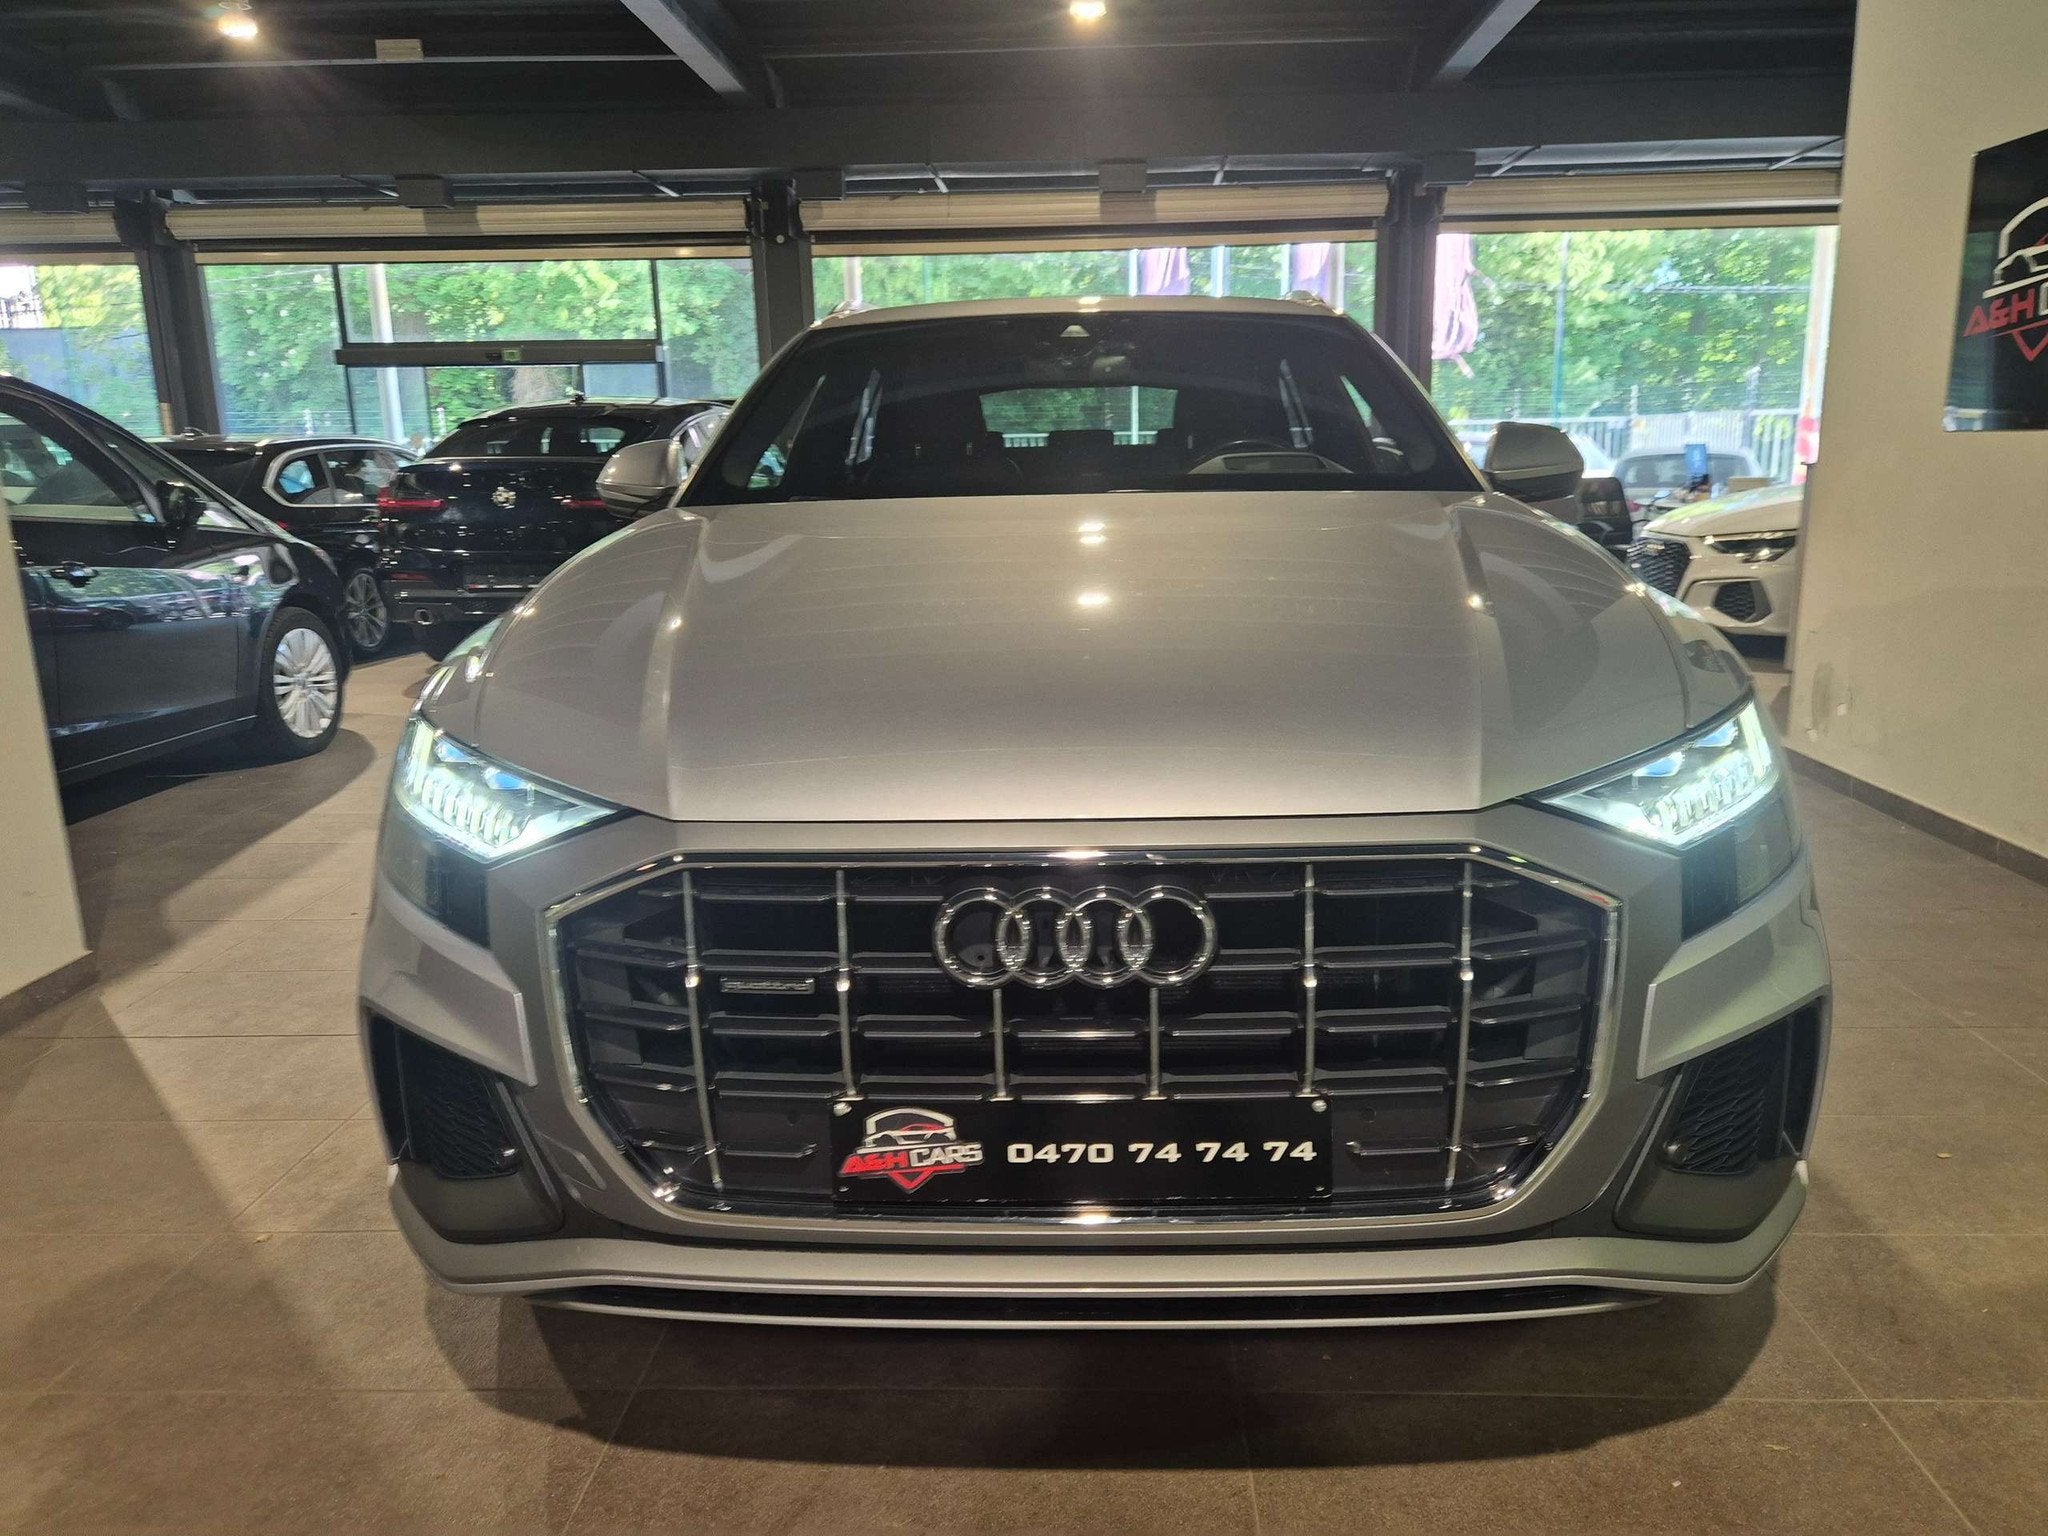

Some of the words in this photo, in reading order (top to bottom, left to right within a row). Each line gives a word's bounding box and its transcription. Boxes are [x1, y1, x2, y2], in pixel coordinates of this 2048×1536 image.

[1006, 1142, 1115, 1164] 0470
[1127, 1142, 1182, 1163] 74
[1195, 1141, 1250, 1163] 74
[1262, 1140, 1318, 1162] 74
